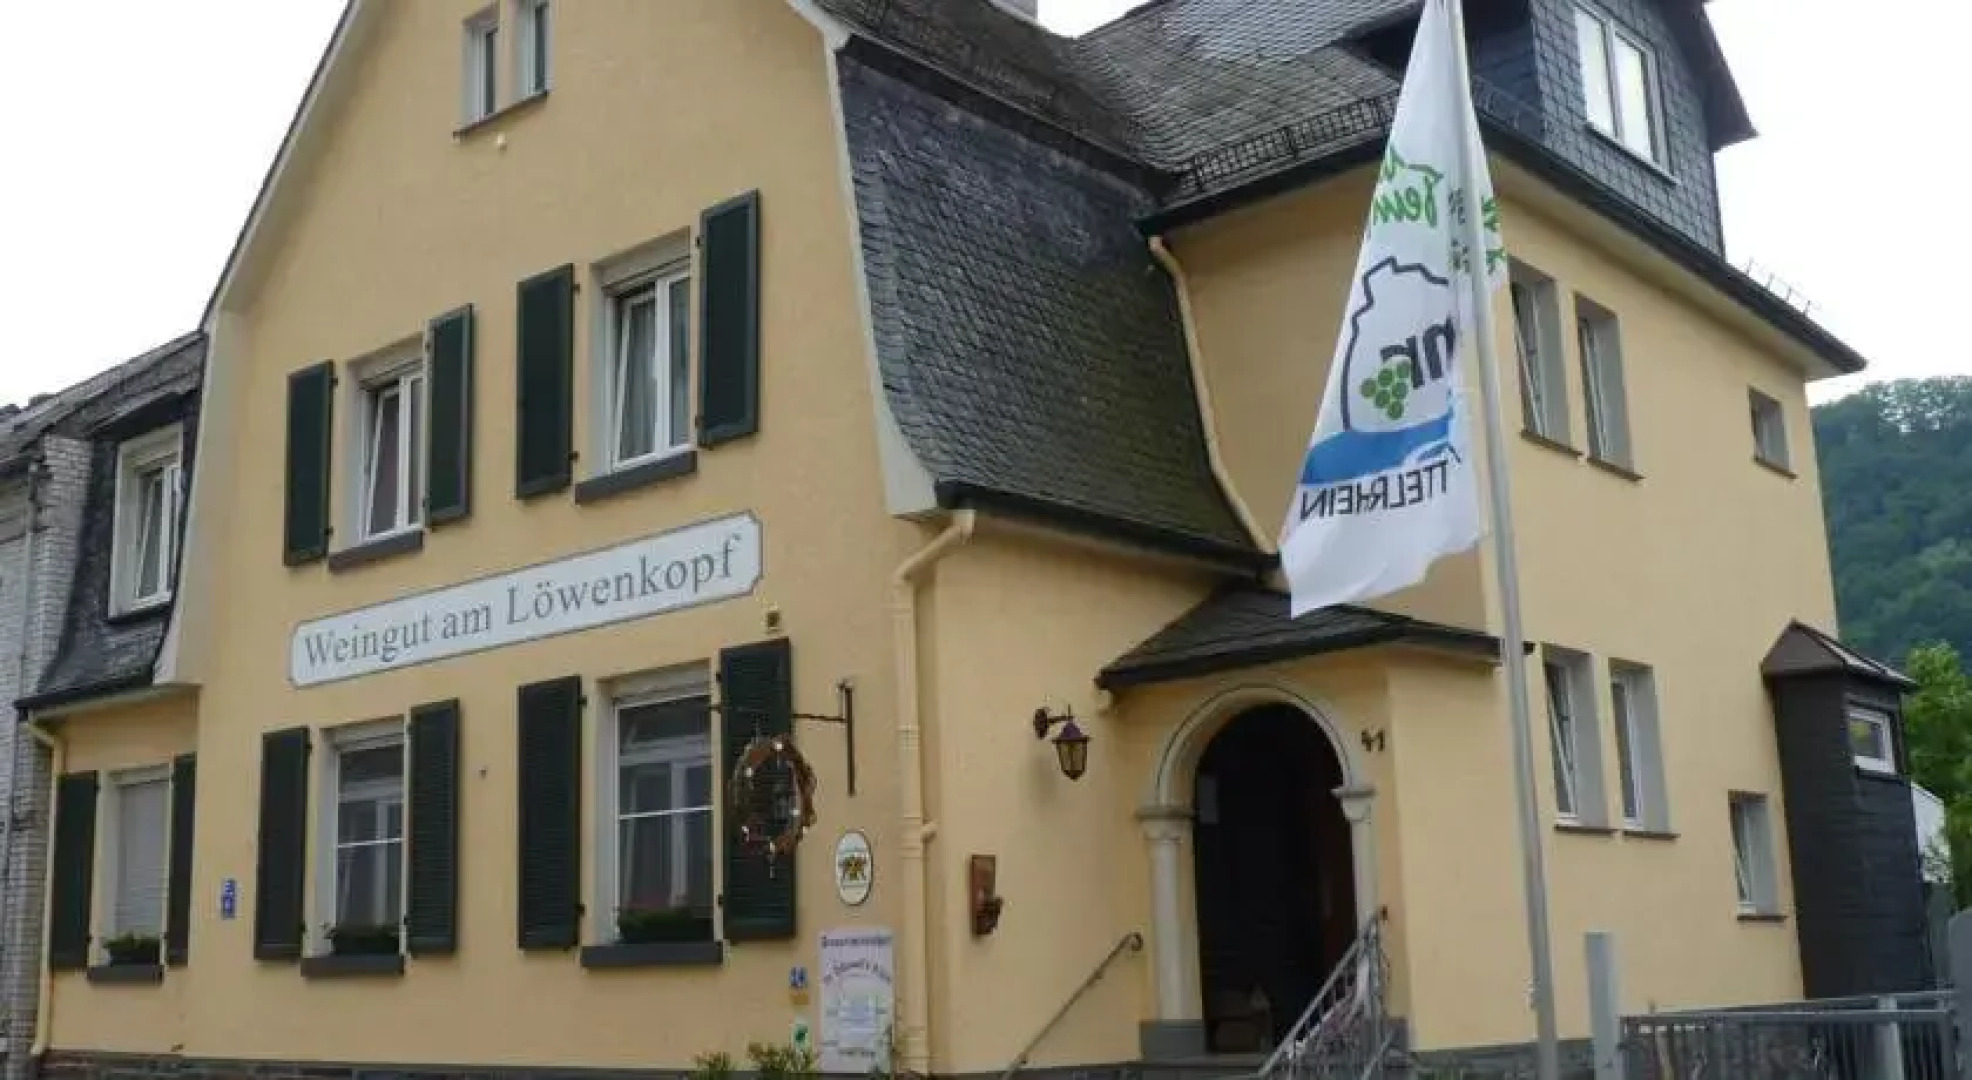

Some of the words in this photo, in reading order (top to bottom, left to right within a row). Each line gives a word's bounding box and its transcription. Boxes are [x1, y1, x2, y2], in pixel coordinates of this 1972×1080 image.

[303, 616, 433, 663] Weingut
[441, 602, 492, 640] am
[506, 533, 742, 625] Löwenkopf
[1361, 728, 1385, 752] 41
